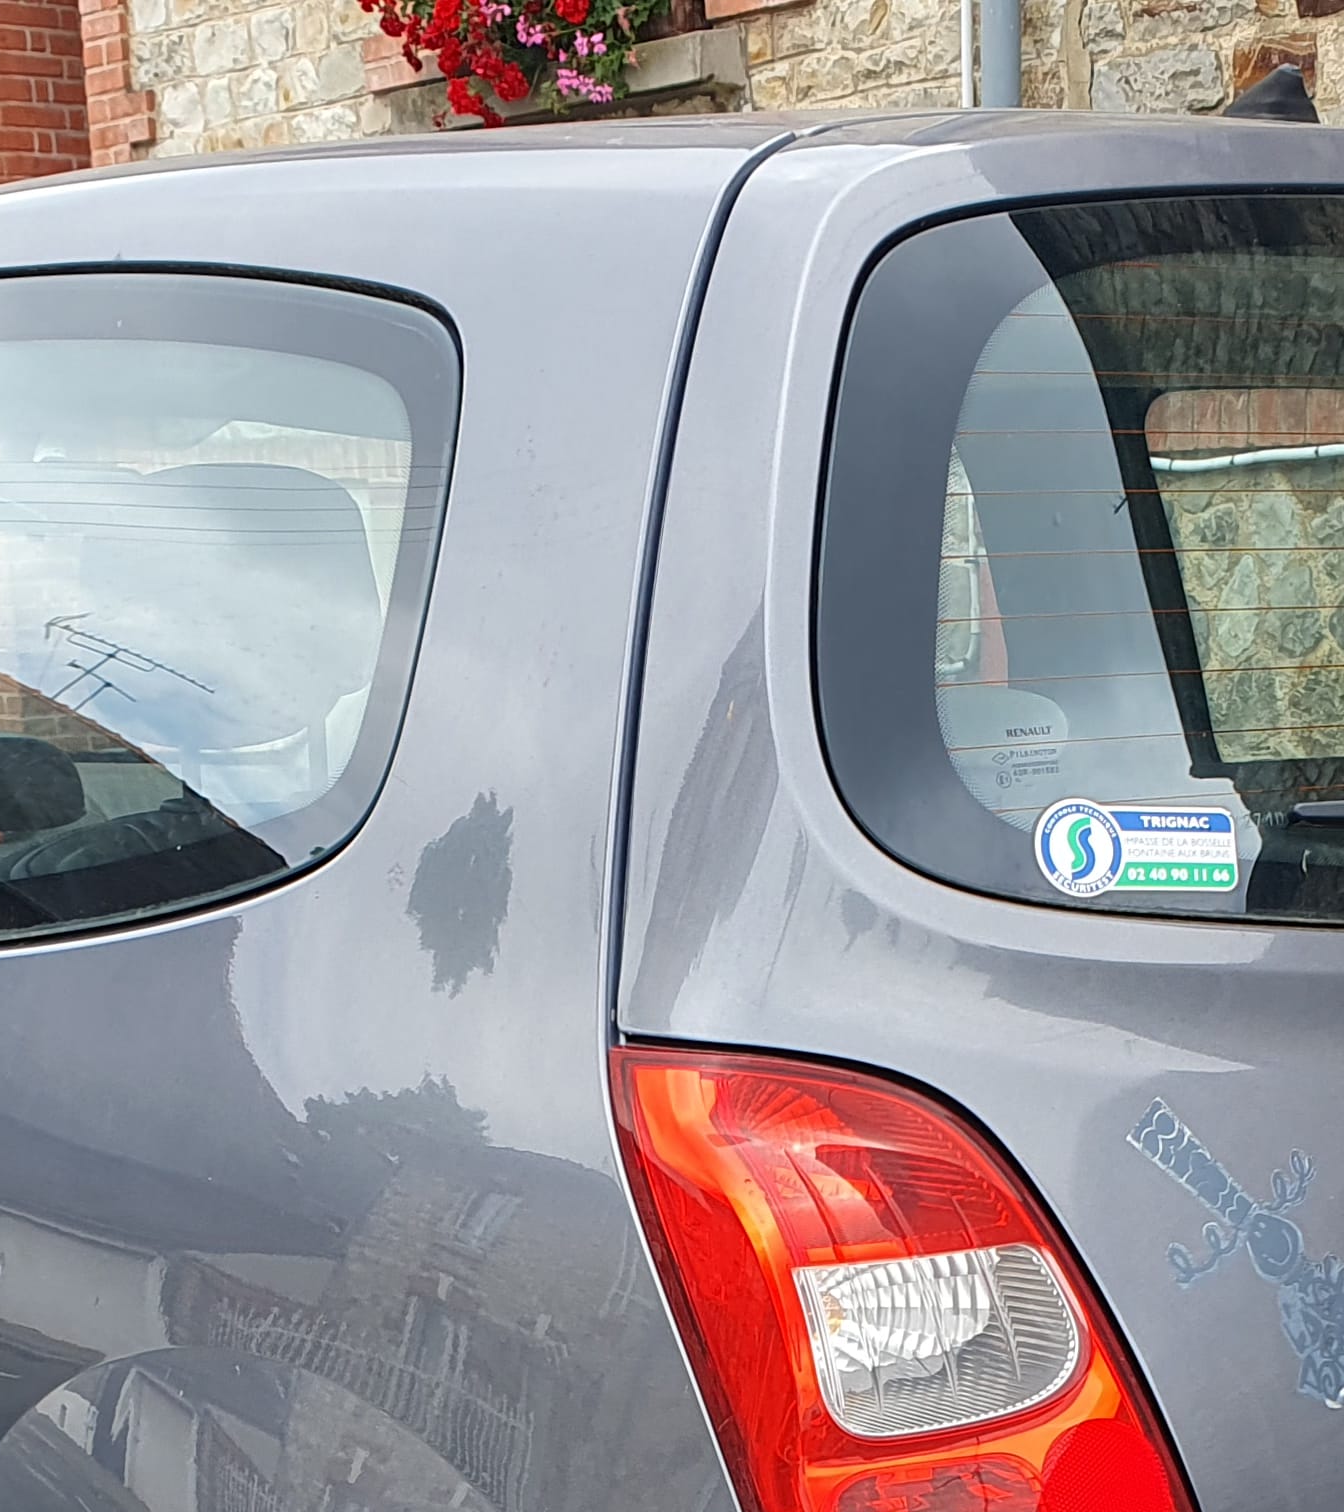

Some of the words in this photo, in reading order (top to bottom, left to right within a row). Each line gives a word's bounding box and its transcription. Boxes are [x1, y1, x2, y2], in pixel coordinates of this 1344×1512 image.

[1006, 726, 1052, 738] RENAULT
[1140, 816, 1210, 828] TRIGNAC
[1162, 837, 1173, 847] DE
[1177, 838, 1188, 847] LA
[1128, 848, 1175, 858] FONTAINE
[1178, 849, 1197, 858] AUX
[1127, 867, 1146, 881] 02
[1149, 867, 1167, 881] 40
[1170, 867, 1188, 881] 90
[1193, 868, 1208, 882] 11
[1213, 868, 1230, 882] 66
